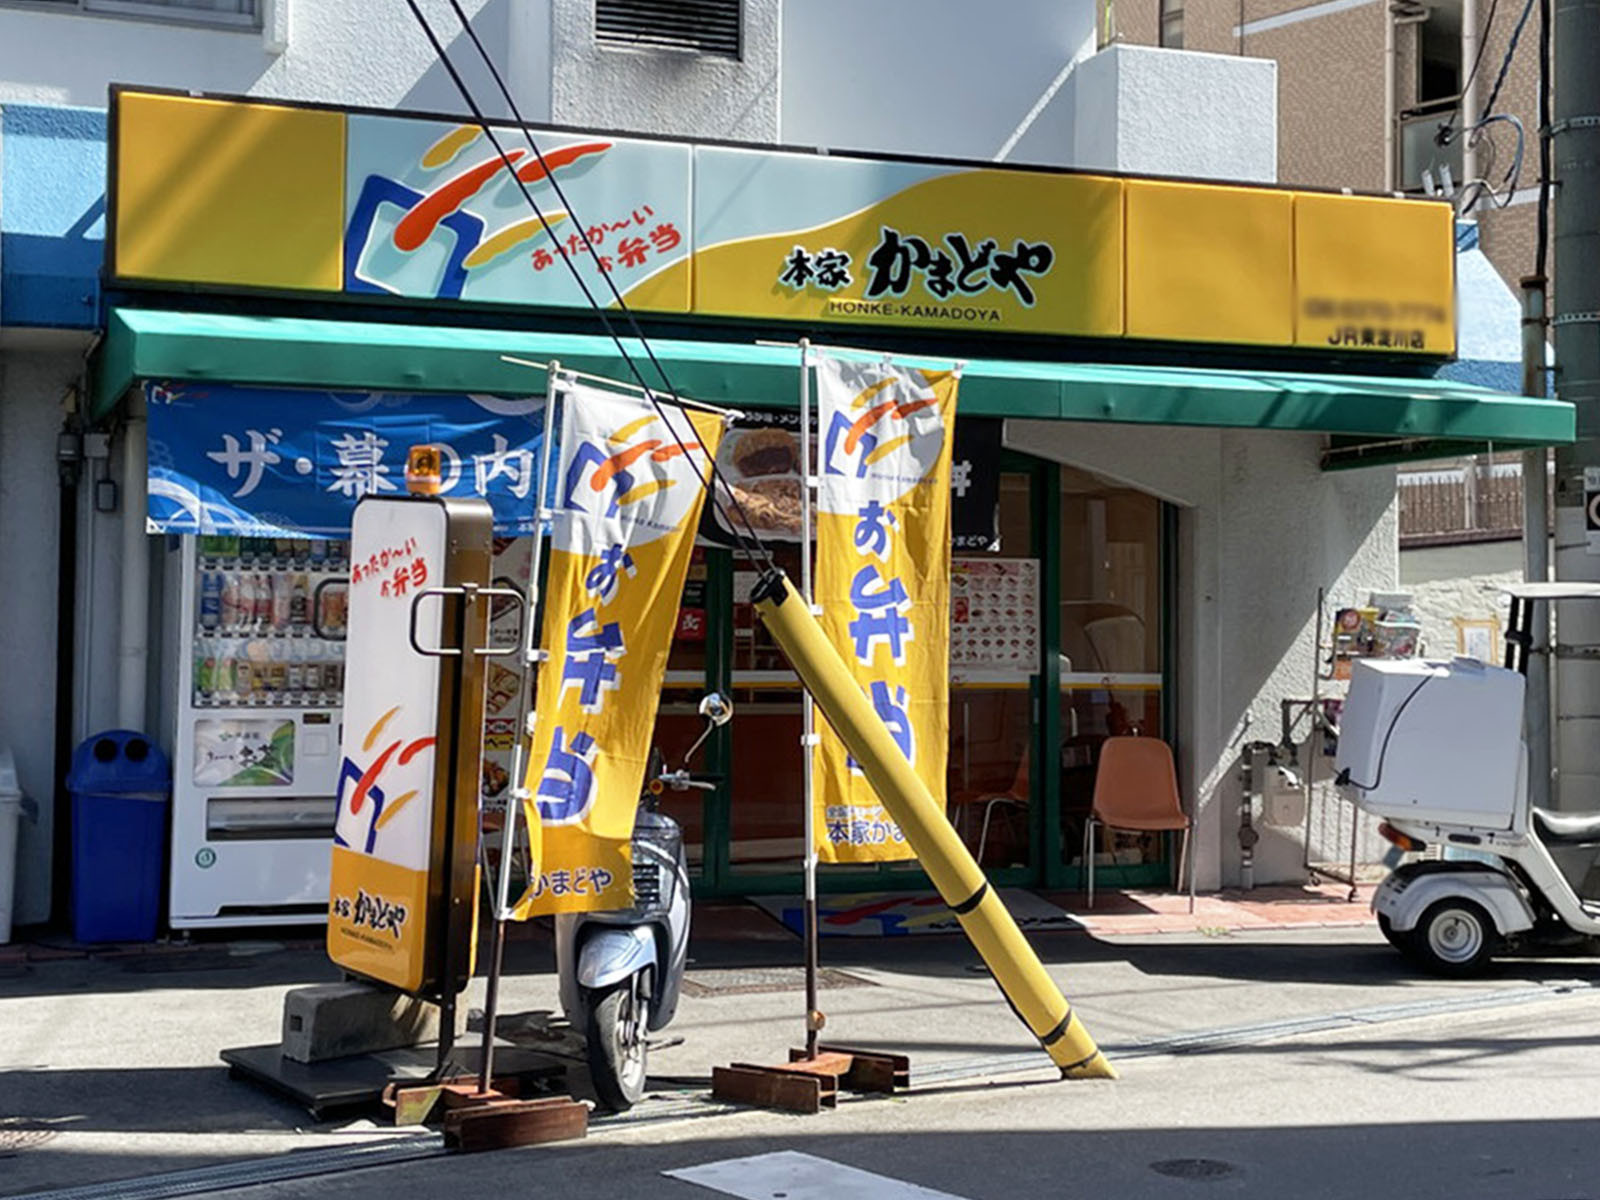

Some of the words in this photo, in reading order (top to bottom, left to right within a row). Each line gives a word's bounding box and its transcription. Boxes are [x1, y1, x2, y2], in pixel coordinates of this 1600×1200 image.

[597, 222, 682, 274] お弁当
[780, 246, 853, 291] 本家
[867, 227, 1053, 306] かまどや
[829, 301, 1001, 321] HONKE-KAMADOYA
[950, 535, 989, 548] まどや
